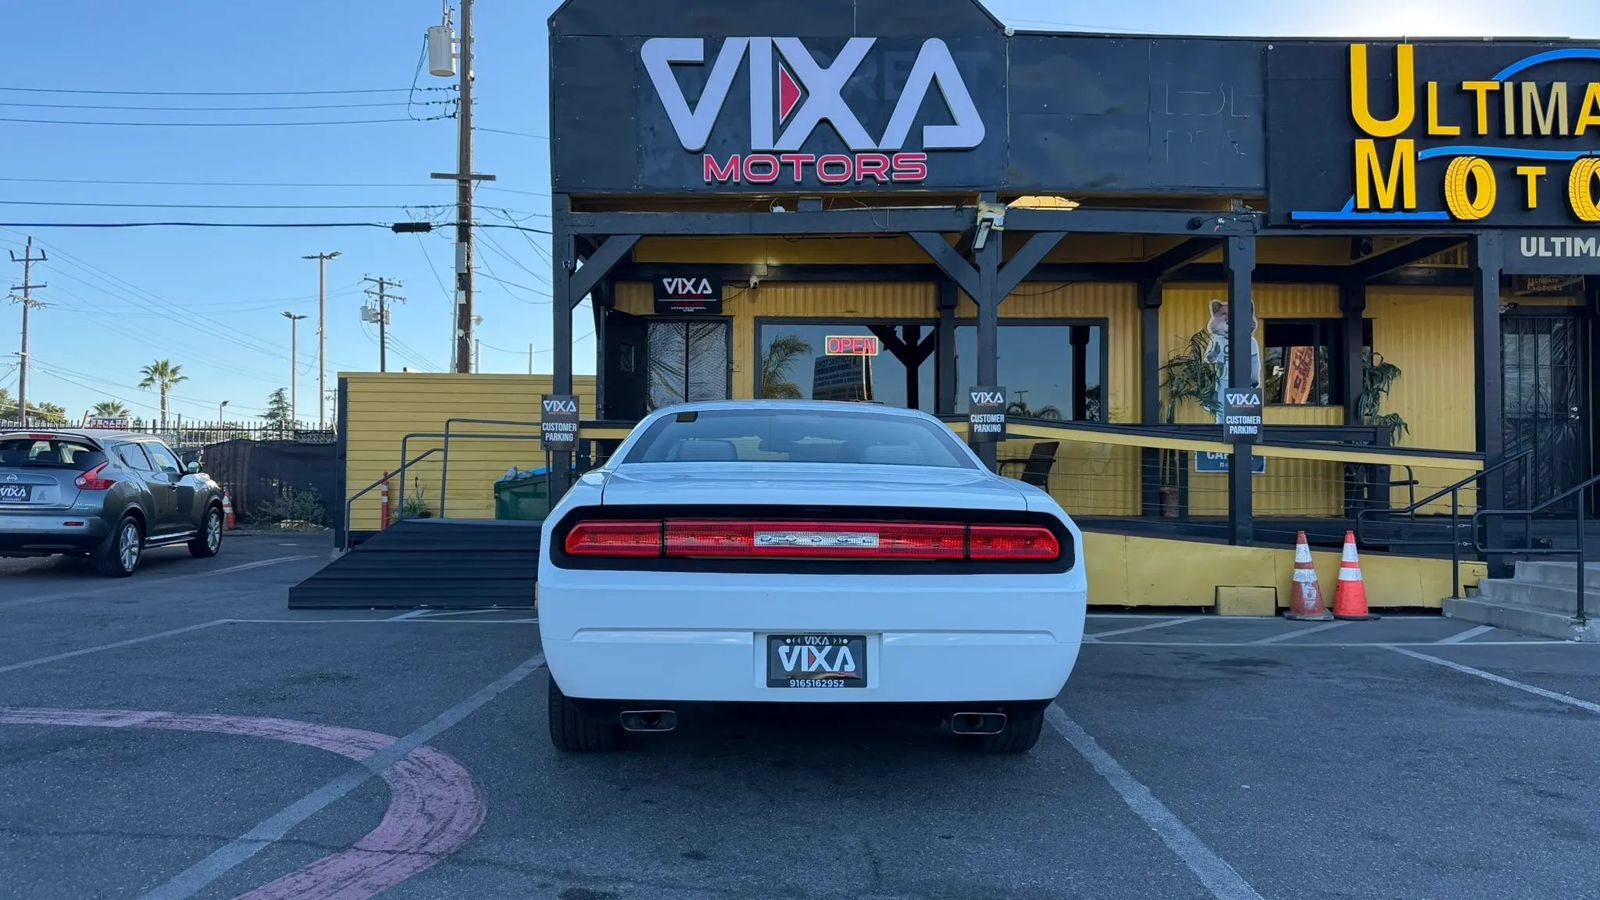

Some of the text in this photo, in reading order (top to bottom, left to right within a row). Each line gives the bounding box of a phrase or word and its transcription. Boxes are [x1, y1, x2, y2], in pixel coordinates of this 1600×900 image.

[640, 36, 986, 152] VIXA
[703, 152, 928, 184] MOTORS
[1520, 236, 1600, 257] ULTIM
[662, 278, 712, 294] VIXA
[828, 338, 876, 354] OPEN
[971, 392, 1004, 404] VIXA
[1226, 393, 1260, 405] VIXA
[543, 400, 577, 412] VIXA
[970, 414, 1005, 423] CUSTOMER
[1226, 416, 1261, 425] CUSTOMER
[542, 422, 577, 432] CUSTOMER
[973, 423, 1002, 433] PARKING
[1229, 425, 1258, 435] PARKING
[545, 432, 574, 442] PARKING
[805, 636, 830, 645] VIXA
[778, 645, 856, 672] VIXA
[790, 679, 845, 688] 9165162952
